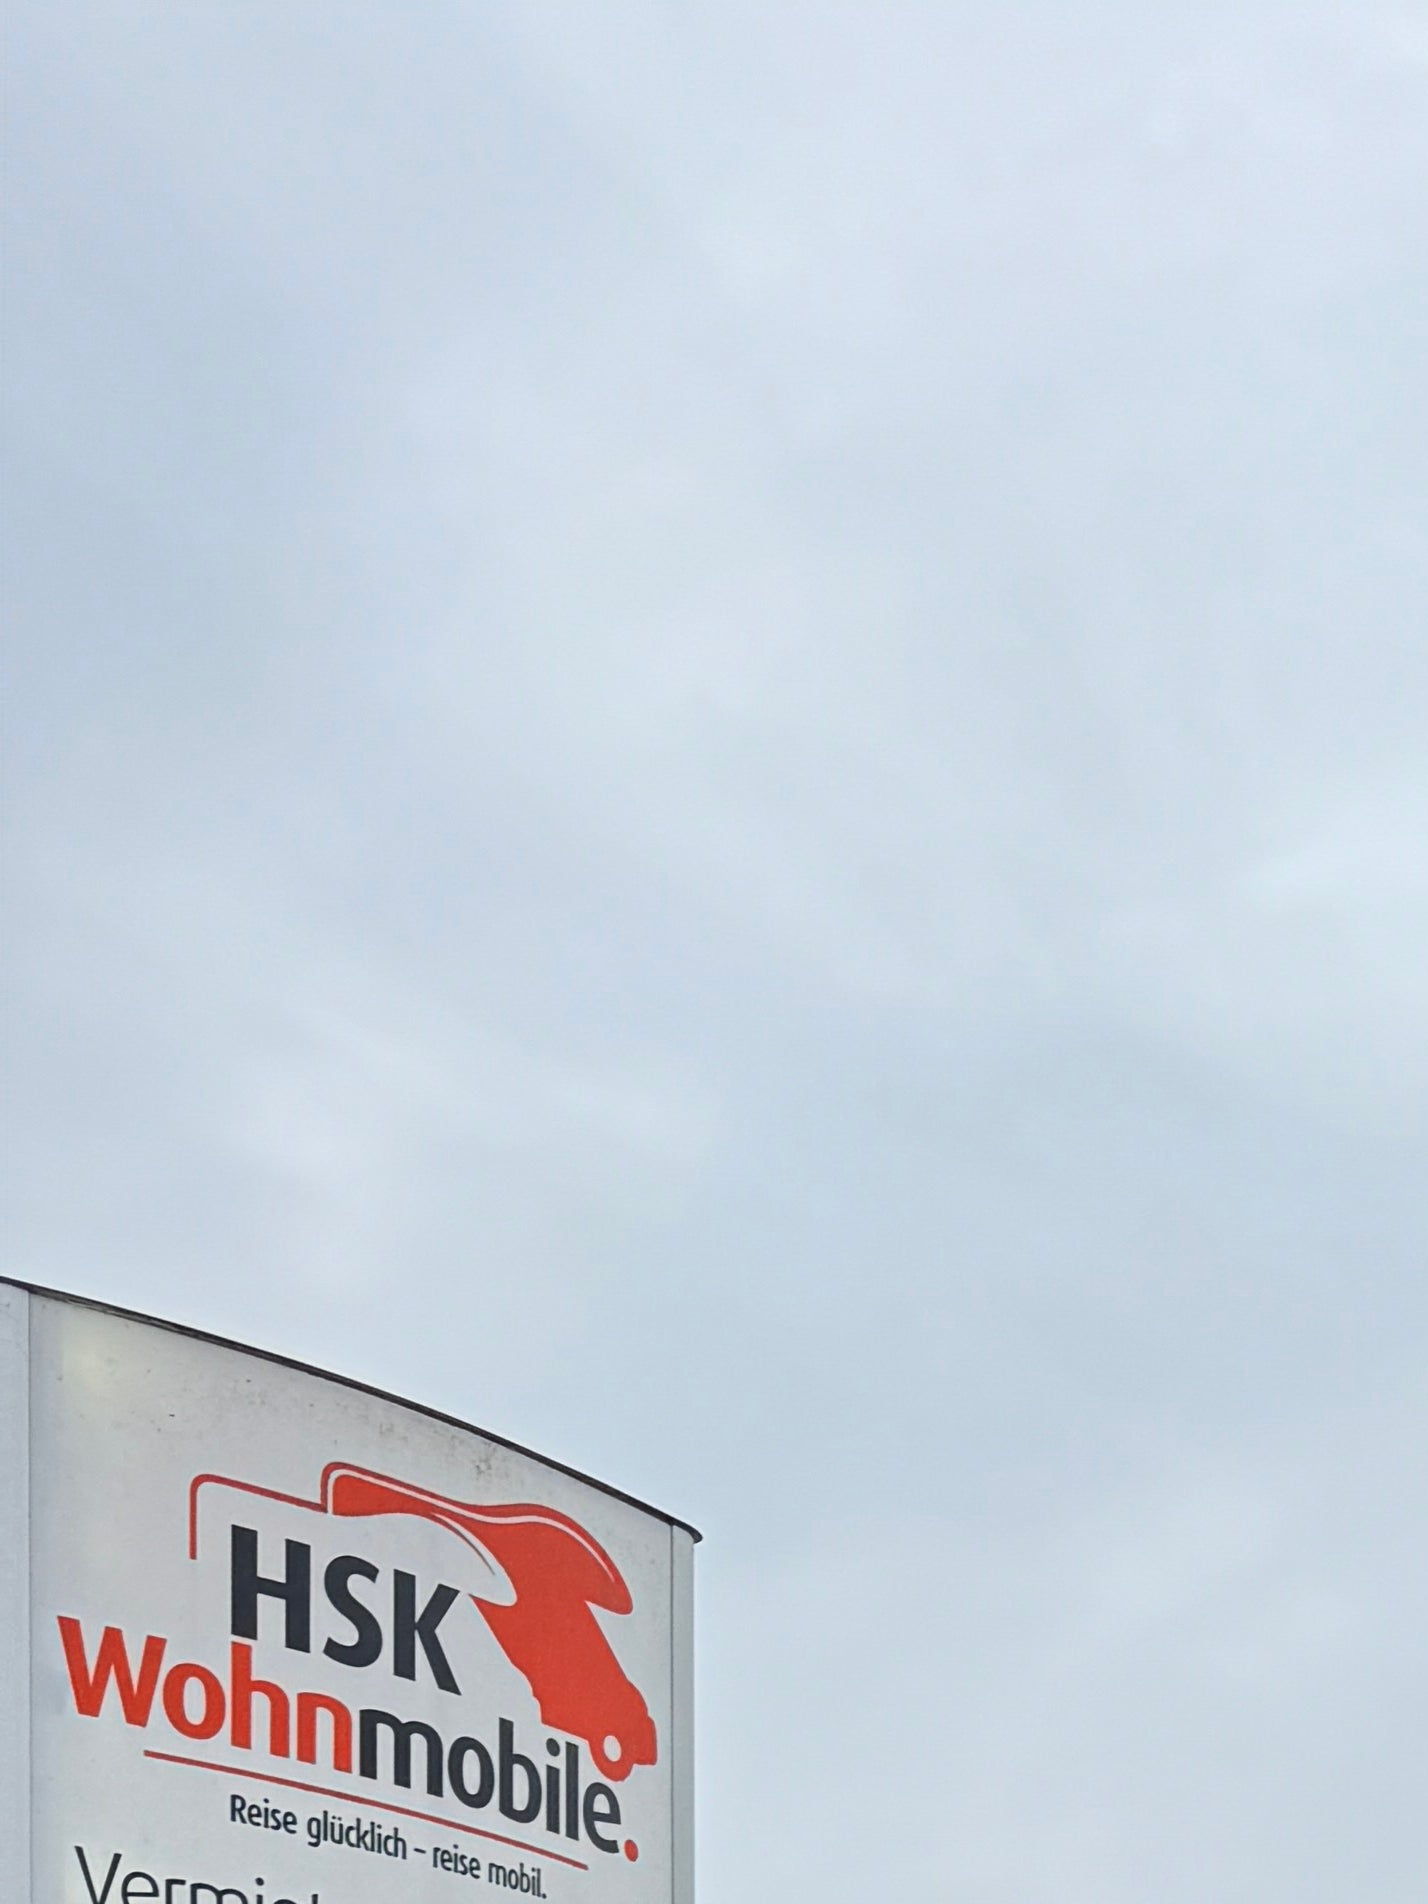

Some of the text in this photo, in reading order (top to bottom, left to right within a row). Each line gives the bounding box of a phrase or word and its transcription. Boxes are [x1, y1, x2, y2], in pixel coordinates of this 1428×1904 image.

[230, 1524, 463, 1696] HSK
[229, 1794, 298, 1836] Reise
[307, 1807, 407, 1861] glücklich
[432, 1845, 480, 1879] reise
[487, 1862, 547, 1900] mobil.
